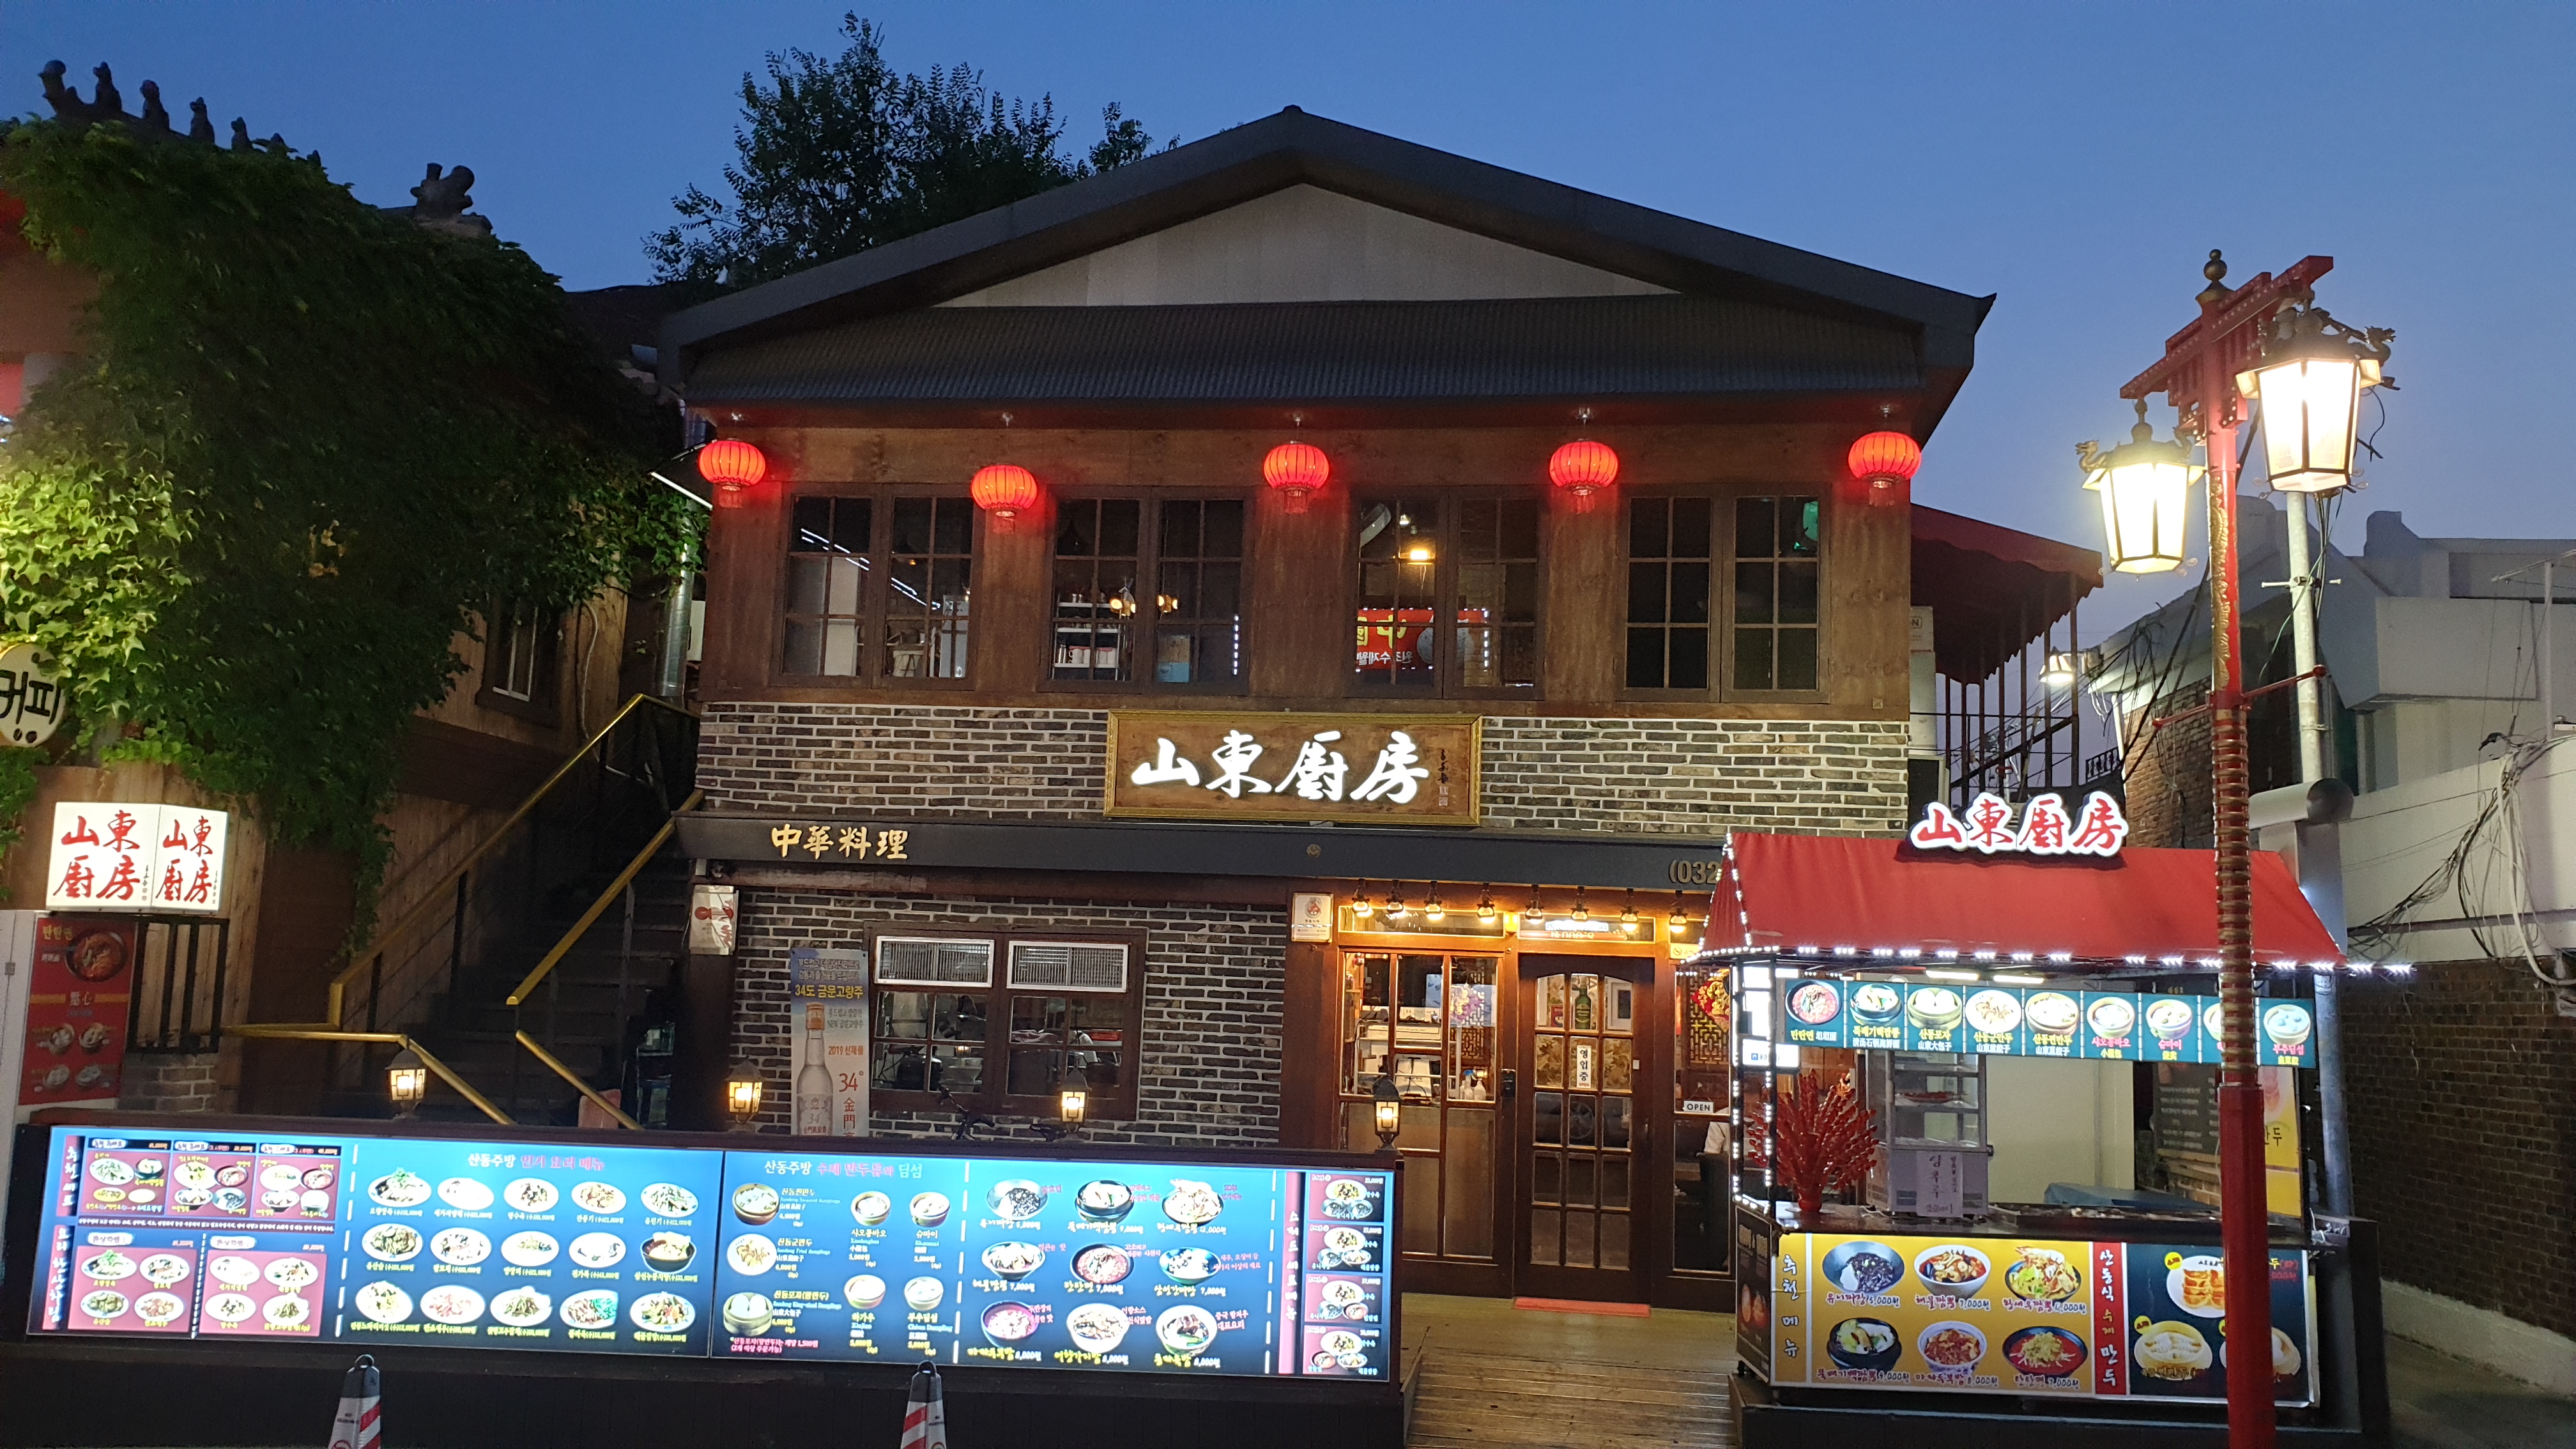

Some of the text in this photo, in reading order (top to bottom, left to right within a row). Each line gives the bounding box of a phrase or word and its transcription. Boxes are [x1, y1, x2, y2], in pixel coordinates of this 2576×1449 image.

[0, 670, 62, 725] 커피
[61, 809, 140, 853] 山東
[162, 815, 213, 857] 山東
[771, 823, 908, 860] 中華料理
[1669, 860, 1722, 884] (032
[795, 985, 816, 997] 34도
[1919, 1029, 1952, 1041] 산동포자
[1973, 1031, 2014, 1045] 산동군만두
[828, 1045, 844, 1055] 2019
[2158, 1039, 2182, 1051] 슈마이
[2273, 1043, 2304, 1056] 부추딤섬
[1579, 1048, 1589, 1082] 영업중
[468, 1153, 606, 1171] 산동주방 인기 요리 메뉴
[764, 1160, 812, 1175] 산동주방
[816, 1162, 841, 1176] 수제
[898, 1163, 923, 1179] 딤섬
[916, 1229, 939, 1239] 슈마이
[2099, 1248, 2114, 1301] 산동식
[1096, 1284, 1124, 1294] 7,000원
[1781, 1254, 1800, 1358] 추천 메뉴
[1827, 1292, 1901, 1308] 유니짜장 5,000원
[1915, 1295, 1990, 1311] 해물짬뽕 7,000원
[2003, 1298, 2087, 1315] 왕새우짬뽕 12,000원
[1218, 1320, 1245, 1331] 대표요리
[2100, 1343, 2118, 1388] 만두
[1877, 1372, 1910, 1383] 9,000원
[1915, 1372, 1998, 1388] 마파두부밥 8,000원
[2014, 1374, 2080, 1390] 탄탄면 7,000원
